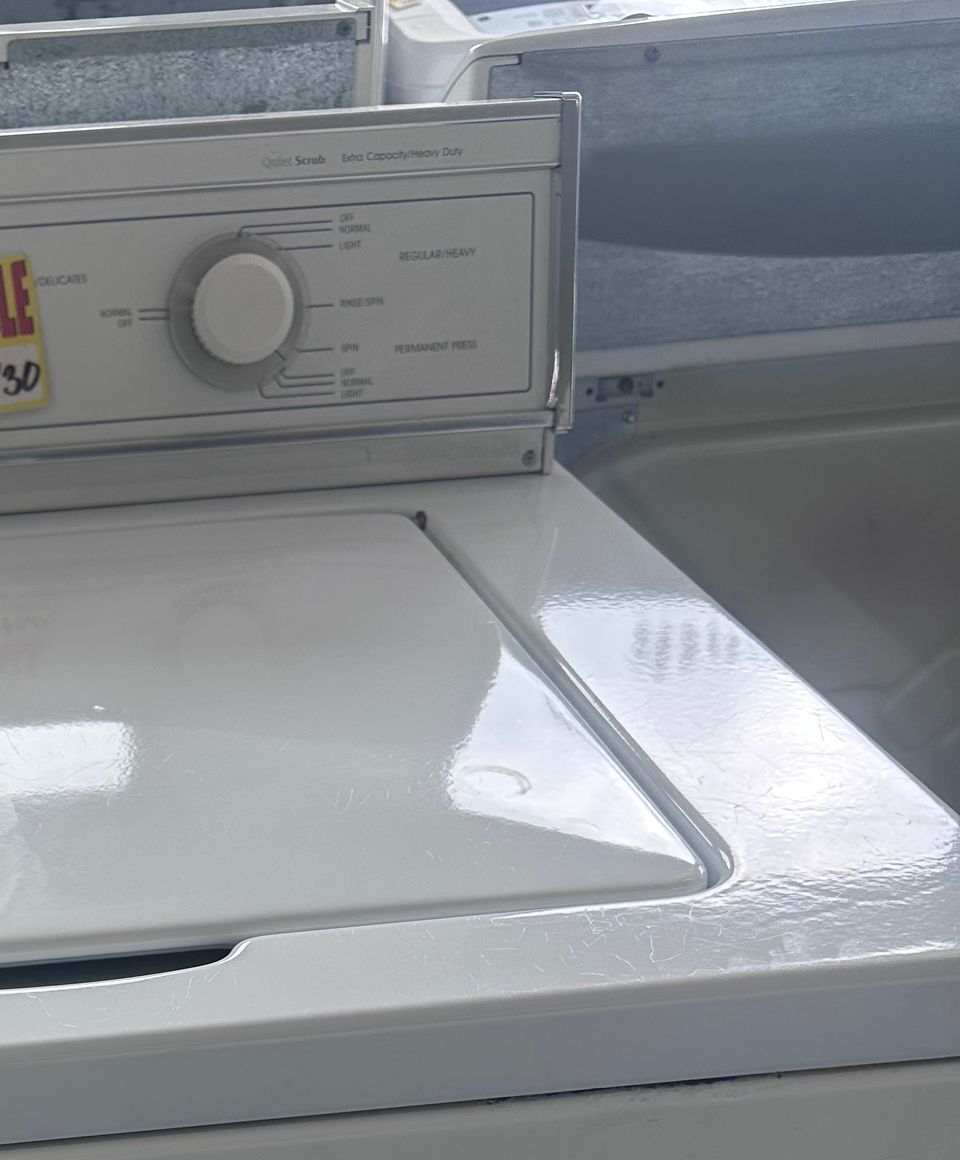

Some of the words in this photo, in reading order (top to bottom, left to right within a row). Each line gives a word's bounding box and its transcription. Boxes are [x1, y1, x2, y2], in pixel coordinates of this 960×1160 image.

[295, 153, 326, 166] Scrub
[341, 152, 365, 163] Extra
[442, 146, 464, 157] Duty
[399, 247, 476, 262] REGULAR/HEAVY
[394, 341, 449, 354] PERMANENT
